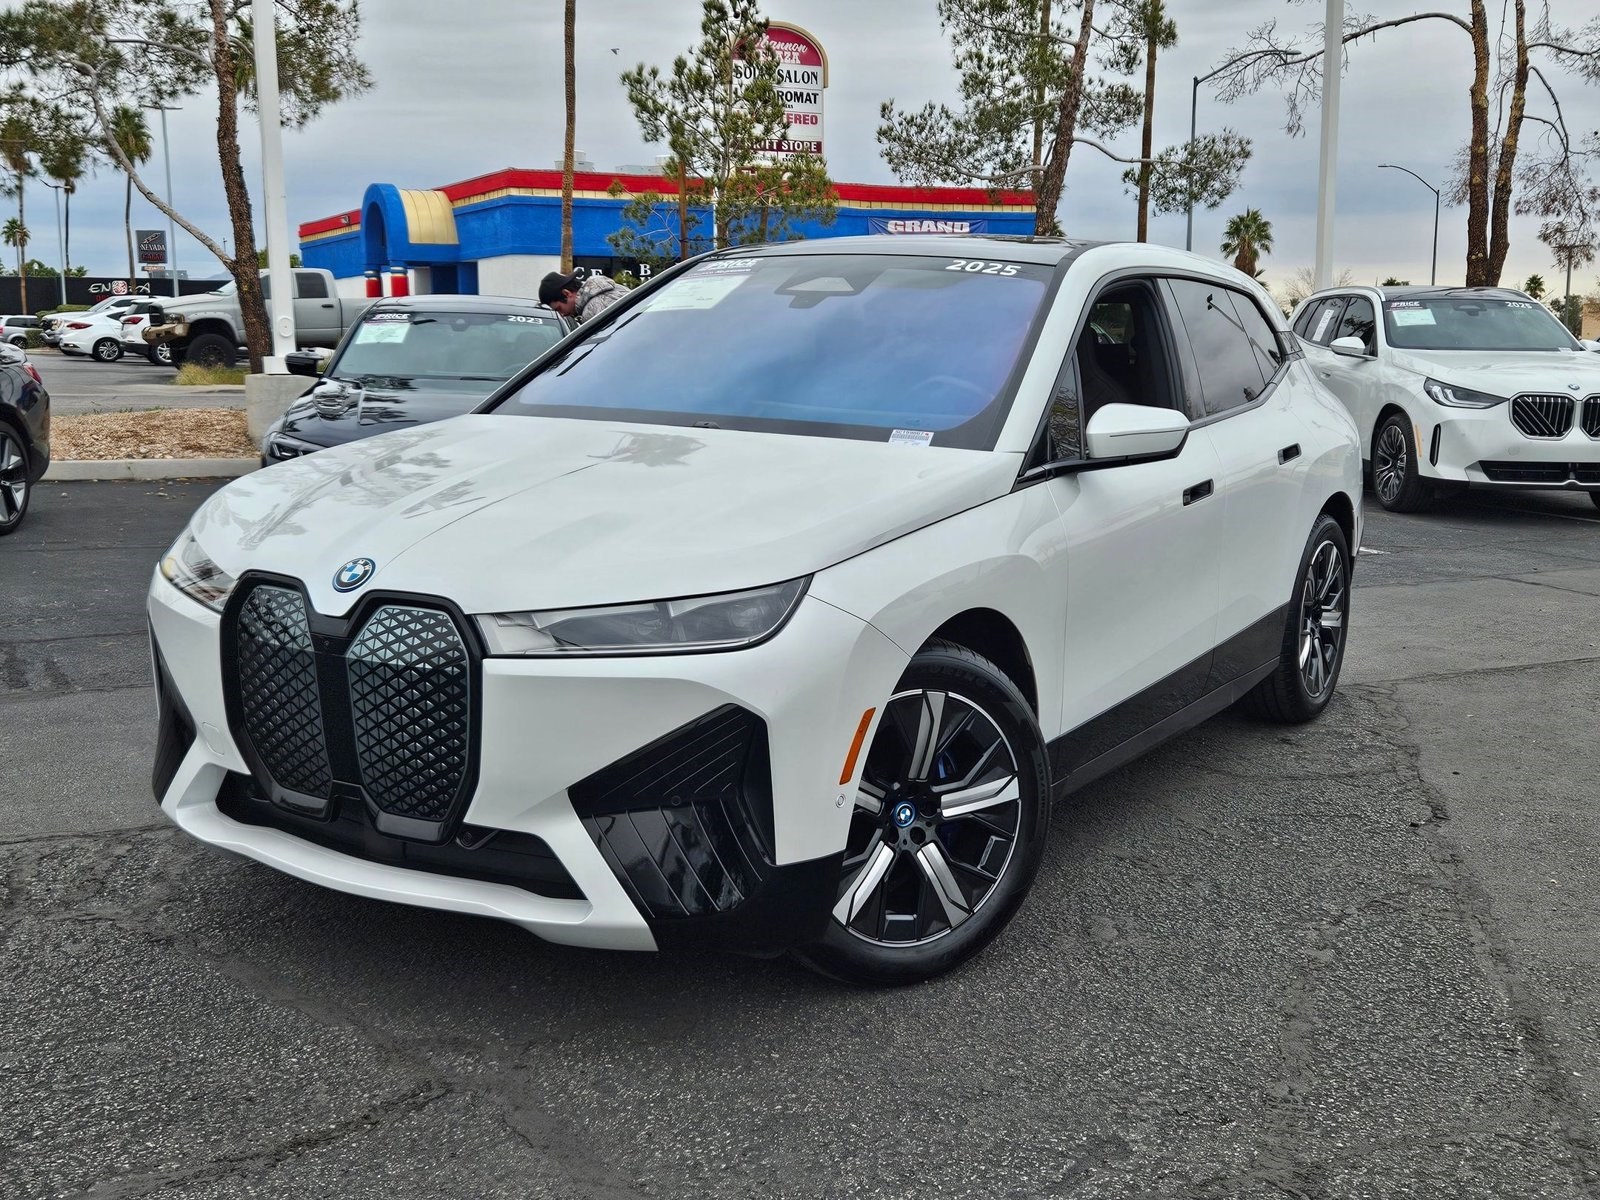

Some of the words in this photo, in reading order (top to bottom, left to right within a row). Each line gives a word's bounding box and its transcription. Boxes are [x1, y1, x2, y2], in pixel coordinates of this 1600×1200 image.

[777, 68, 819, 85] SALON
[781, 140, 818, 152] STORE
[887, 220, 970, 233] GRAND
[945, 259, 1021, 276] 2025
[507, 315, 543, 325] 2023
